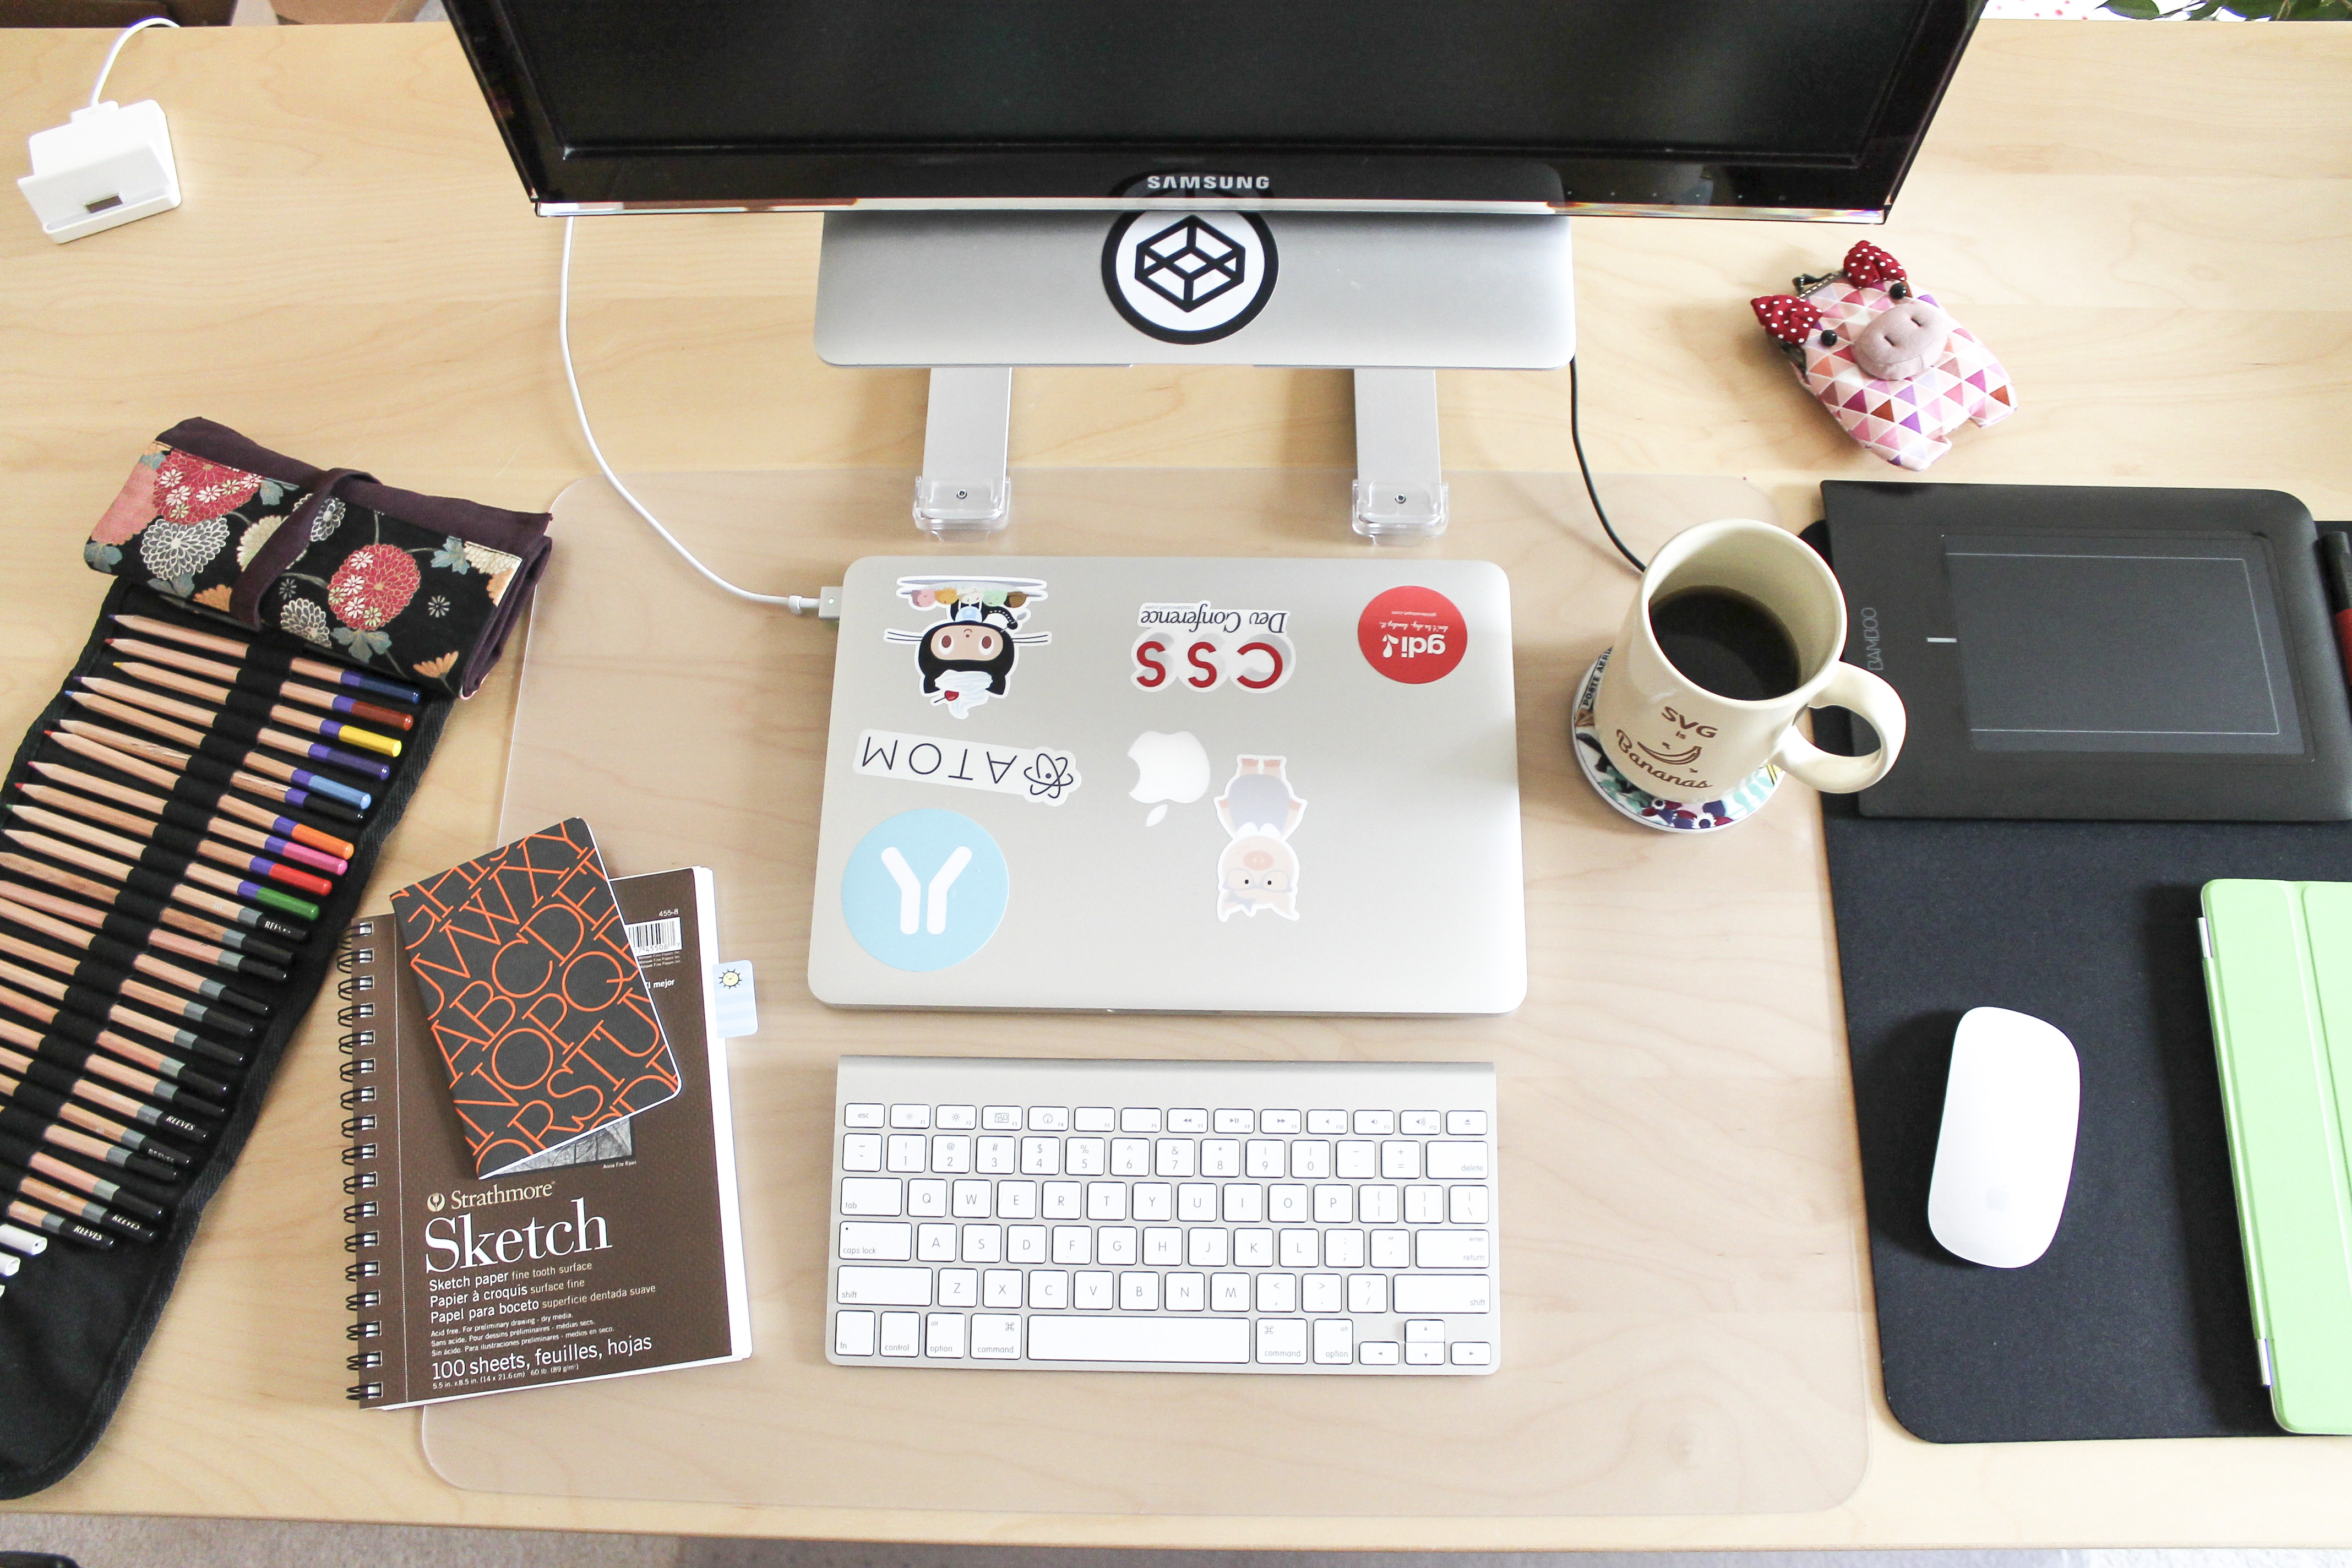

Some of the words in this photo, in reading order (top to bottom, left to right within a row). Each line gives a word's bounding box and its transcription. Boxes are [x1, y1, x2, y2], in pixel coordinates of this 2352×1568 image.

[1147, 175, 1270, 189] SAMSUNG
[1140, 603, 1242, 633] Conference
[1249, 611, 1288, 634] Dev
[1861, 607, 1883, 671] BAMBOO
[1136, 640, 1283, 689] CSS
[1660, 705, 1718, 739] SVG
[862, 736, 1017, 784] ATOM
[1615, 728, 1714, 788] Bananas
[658, 907, 679, 917] 455-8
[653, 978, 676, 989] mejor
[165, 1115, 196, 1131] REEVES
[946, 1156, 954, 1167] 2
[991, 1157, 998, 1168] 3
[1036, 1158, 1043, 1168] 4
[1081, 1158, 1088, 1169] 5
[1125, 1158, 1133, 1169] 6
[1172, 1159, 1179, 1170] 7
[1216, 1159, 1224, 1170] 8
[1261, 1160, 1269, 1171] 9
[1306, 1161, 1315, 1172] 0
[451, 1183, 553, 1210] Strathmore
[922, 1193, 932, 1204] Q
[965, 1194, 978, 1206] W
[1013, 1194, 1020, 1206] E
[1058, 1195, 1065, 1207] R
[1103, 1195, 1110, 1207] T
[1148, 1196, 1156, 1208] Y
[1193, 1197, 1202, 1208] U
[1330, 1197, 1337, 1208] P
[1283, 1197, 1293, 1209] O
[111, 1213, 141, 1231] REEVES
[73, 1224, 103, 1242] REEVES
[424, 1196, 613, 1274] Sketch
[931, 1237, 941, 1249] A
[978, 1238, 986, 1250] S
[1022, 1239, 1031, 1251] D
[1069, 1239, 1076, 1251] F
[1112, 1240, 1122, 1252] G
[1158, 1241, 1167, 1253] H
[1205, 1241, 1211, 1253] J
[1250, 1242, 1258, 1254] K
[1296, 1242, 1303, 1254] L
[861, 1246, 876, 1254] lock
[429, 1275, 470, 1292] Sketch
[475, 1272, 509, 1288] paper
[511, 1271, 530, 1281] fine
[532, 1266, 556, 1278] tooth
[558, 1261, 592, 1274] surface
[430, 1292, 469, 1308] Papier
[472, 1290, 480, 1302] à
[483, 1283, 528, 1301] croquis
[530, 1282, 564, 1294] surface
[567, 1278, 585, 1289] fine
[953, 1282, 961, 1294] Z
[998, 1284, 1007, 1295] X
[1044, 1284, 1053, 1296] C
[1089, 1285, 1098, 1297] V
[1135, 1286, 1144, 1298] B
[1180, 1286, 1190, 1298] N
[1224, 1287, 1237, 1298] M
[430, 1308, 465, 1325] Papel
[469, 1306, 495, 1322] para
[499, 1299, 540, 1315] boceto
[542, 1294, 588, 1309] superficie
[590, 1288, 628, 1302] dentada
[630, 1284, 656, 1296] suave
[430, 1329, 445, 1337] Acid
[474, 1320, 510, 1332] preliminary
[510, 1316, 536, 1327] drawing
[541, 1315, 552, 1323] dry
[552, 1312, 574, 1320] media.
[431, 1339, 447, 1348] Sans
[469, 1334, 484, 1342] Pour
[485, 1331, 509, 1340] dessins
[431, 1349, 443, 1357] Sin
[480, 1339, 520, 1351] ilustraciones
[521, 1334, 560, 1346] preliminares
[565, 1330, 588, 1338] medios
[839, 1341, 847, 1349] fn
[432, 1359, 466, 1380] 100
[469, 1353, 531, 1375] sheets,
[535, 1343, 603, 1366] feuilles,
[607, 1335, 653, 1357] hojas
[1325, 1350, 1348, 1359] option
